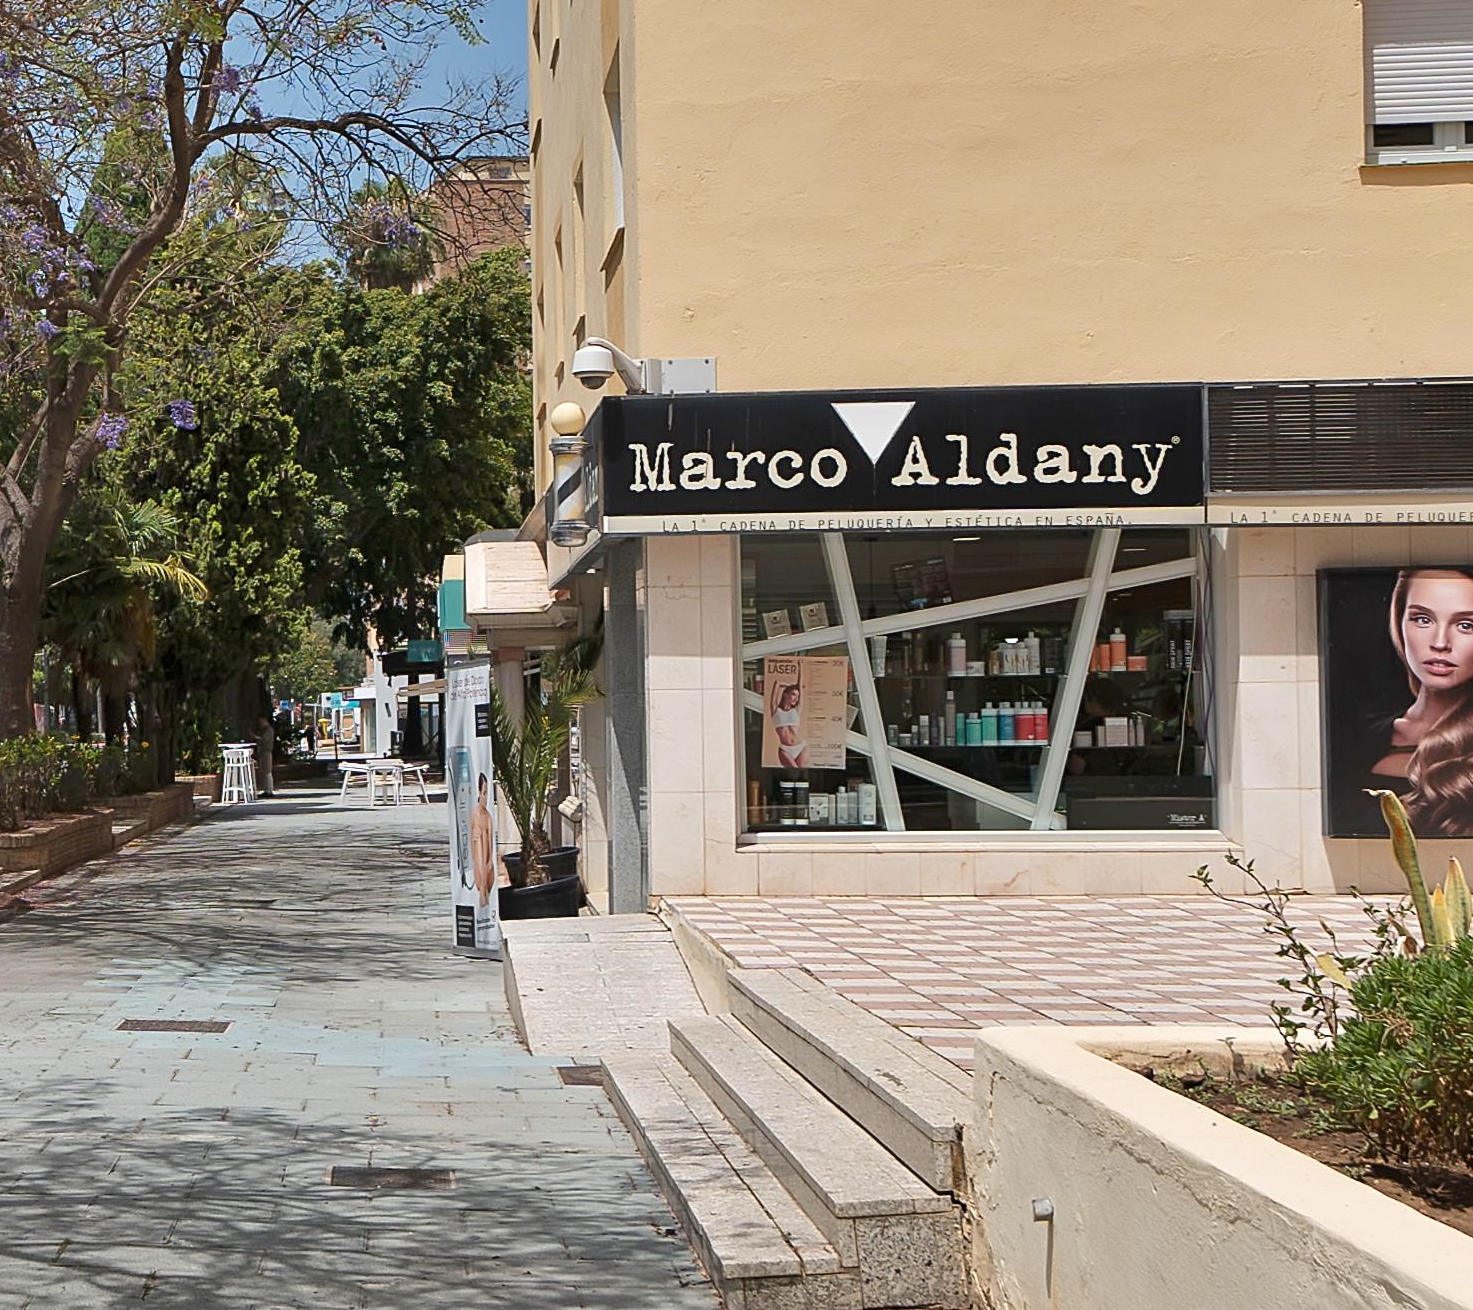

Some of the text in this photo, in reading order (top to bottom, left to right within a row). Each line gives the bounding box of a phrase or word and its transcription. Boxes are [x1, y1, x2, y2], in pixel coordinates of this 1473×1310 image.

[629, 442, 847, 491] Marco
[891, 433, 1172, 495] Aldany
[662, 520, 679, 531] LA
[719, 519, 776, 531] CADENA
[789, 519, 805, 530] DE
[818, 515, 913, 529] PELUQUERÍA
[925, 517, 933, 527] Y
[945, 514, 1023, 527] ESTÉTICA
[1036, 516, 1053, 526] EN
[1230, 512, 1248, 524] LA
[1292, 512, 1352, 523] CADENA
[1365, 511, 1382, 522] DE
